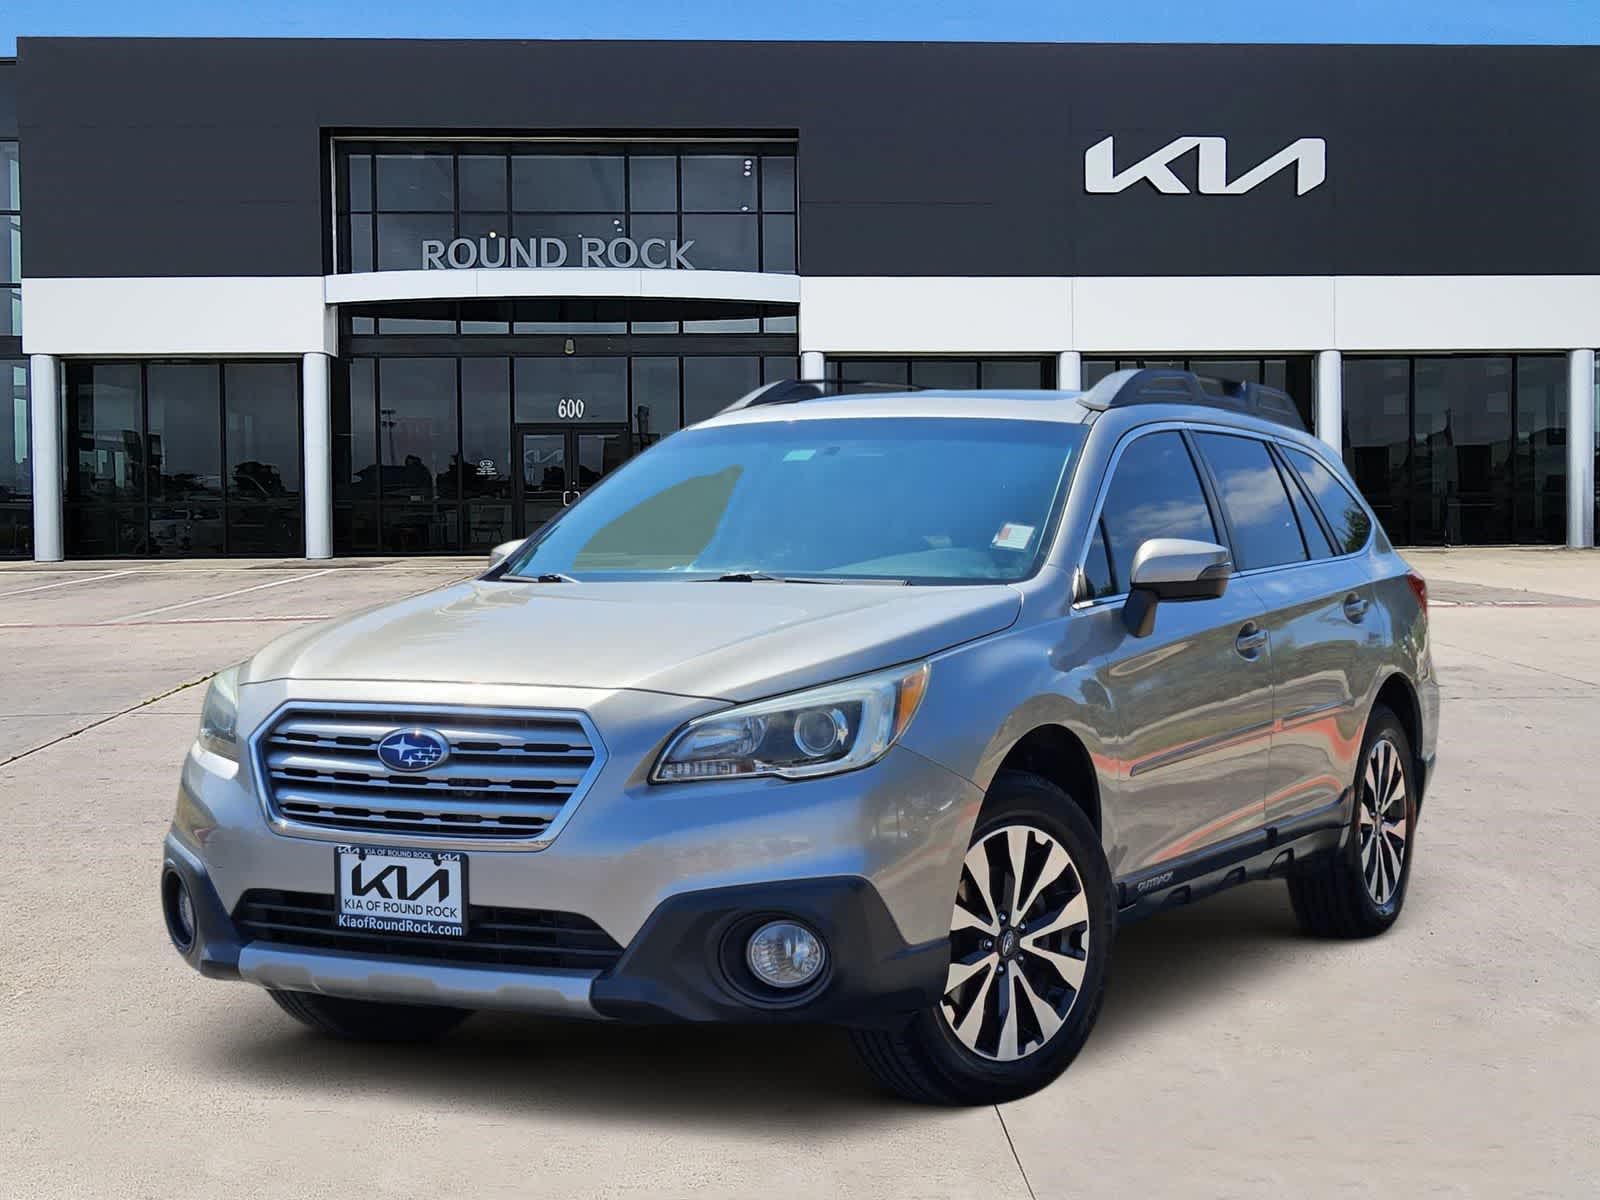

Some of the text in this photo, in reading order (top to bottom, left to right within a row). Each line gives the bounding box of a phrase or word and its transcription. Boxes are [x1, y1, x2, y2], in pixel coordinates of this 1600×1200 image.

[1084, 135, 1327, 196] KIA
[421, 237, 696, 270] ROUND ROCK
[558, 399, 585, 418] 600
[387, 850, 412, 858] ROUND
[413, 851, 433, 860] ROCK
[352, 862, 449, 904] KIA
[344, 899, 457, 919] KIA OF ROUND ROCK
[338, 915, 463, 937] KiaofRoundRock.com
